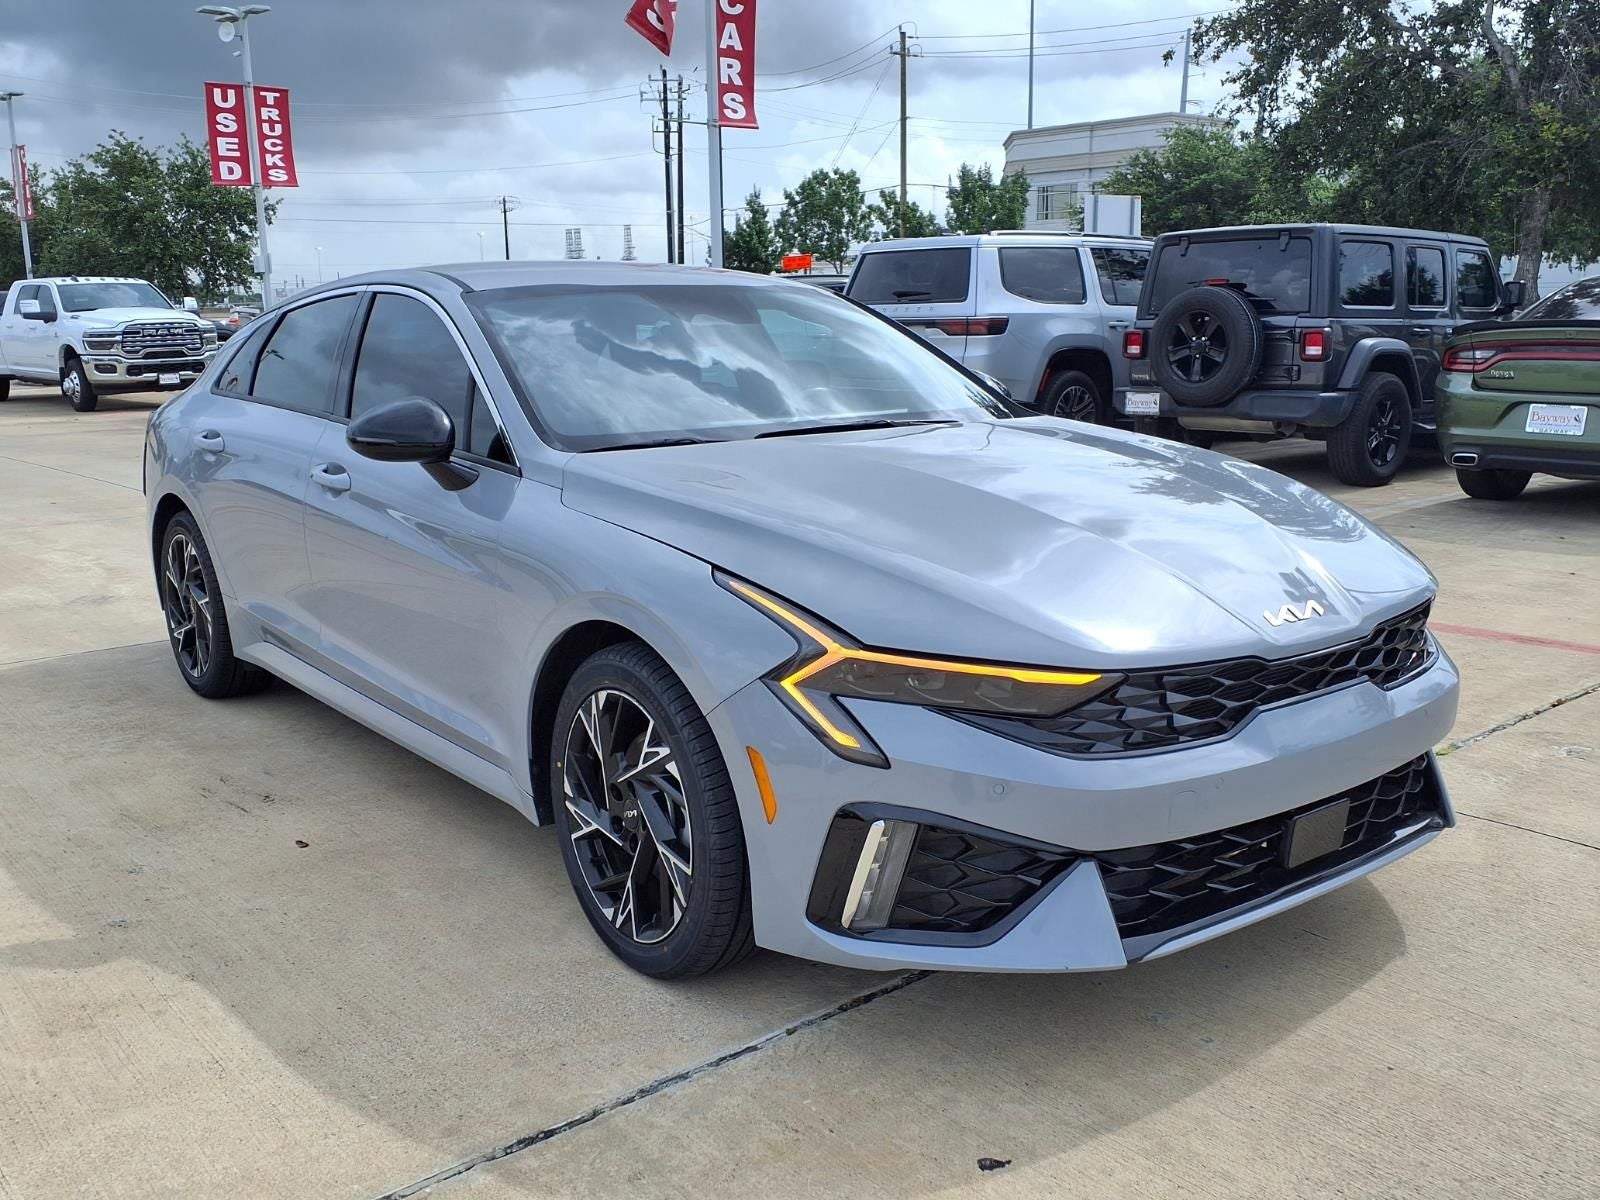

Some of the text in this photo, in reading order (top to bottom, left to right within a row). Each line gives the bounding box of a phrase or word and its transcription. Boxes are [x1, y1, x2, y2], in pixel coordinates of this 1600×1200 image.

[213, 87, 242, 180] USED
[259, 91, 288, 182] TRUCKS
[143, 328, 183, 336] RAM
[1531, 411, 1571, 425] Bayway
[1263, 599, 1324, 627] KIA
